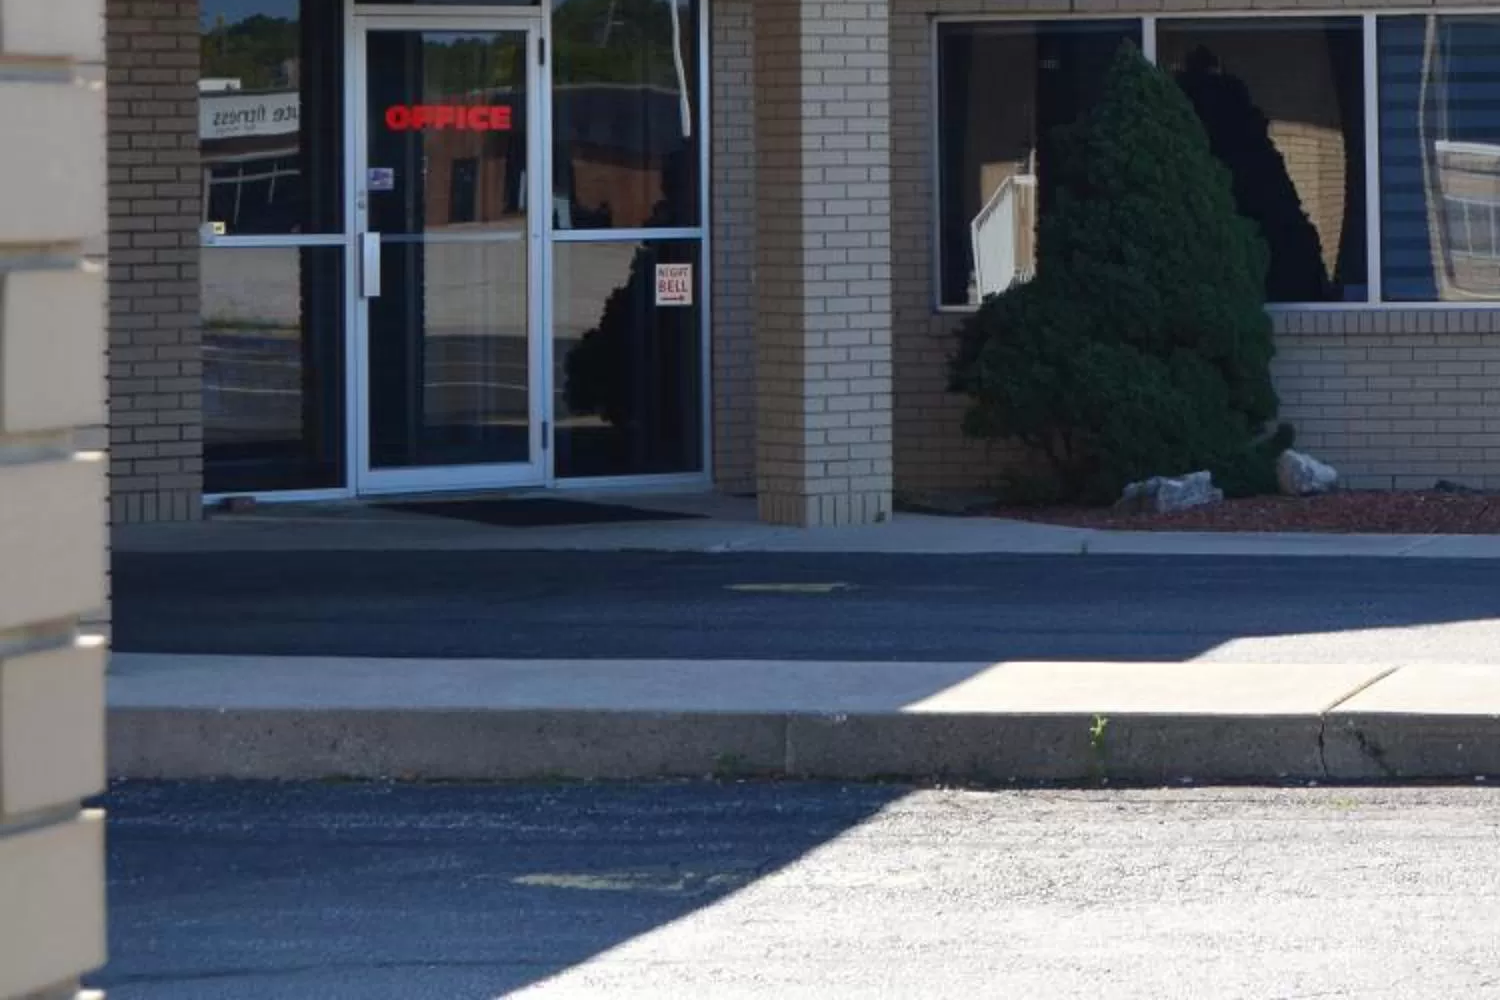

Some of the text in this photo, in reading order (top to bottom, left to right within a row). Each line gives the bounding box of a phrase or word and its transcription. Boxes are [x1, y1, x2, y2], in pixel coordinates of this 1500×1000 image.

[385, 104, 513, 131] OFFICE
[658, 267, 689, 278] NIGHT
[658, 279, 689, 293] BELL
